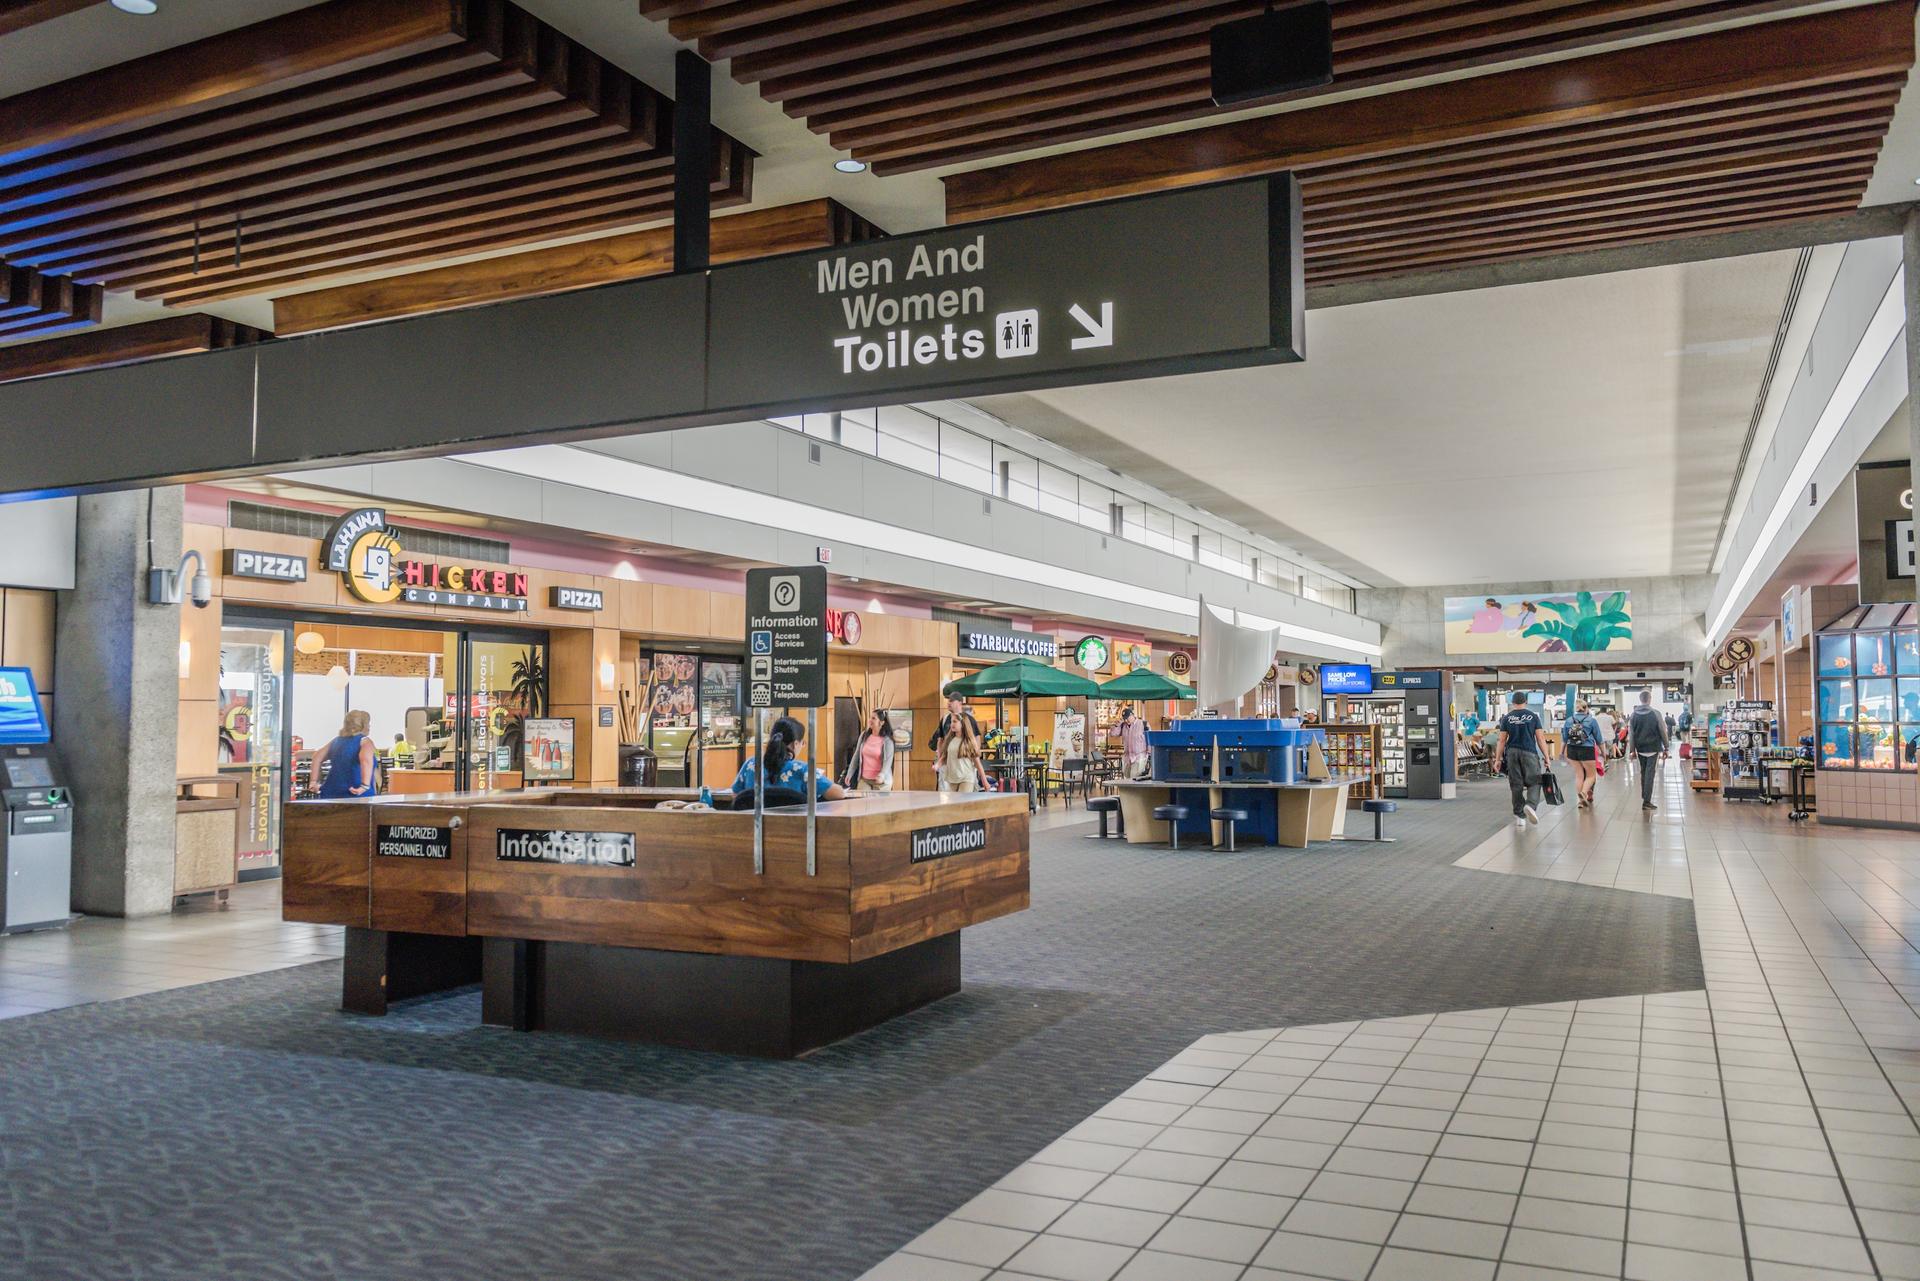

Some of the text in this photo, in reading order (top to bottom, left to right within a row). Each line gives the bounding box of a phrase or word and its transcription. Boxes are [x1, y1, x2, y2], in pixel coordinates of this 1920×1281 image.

[818, 235, 984, 293] Men And
[842, 286, 984, 329] Women
[834, 324, 985, 373] Toilets
[332, 511, 383, 567] LAHAINA
[237, 553, 306, 579] PIZZA
[408, 589, 526, 610] COMPANY
[560, 590, 602, 608] PIZZA
[751, 615, 818, 628] Information
[774, 632, 801, 640] Access
[774, 640, 805, 648] Services
[969, 633, 1058, 657] STARBUCKS COFFEE
[774, 658, 818, 666] Interterminal
[774, 666, 799, 674] Shuttle
[774, 691, 809, 700] Telephone
[258, 783, 271, 842] Flavors
[388, 825, 438, 839] AUTHORIZED
[913, 825, 985, 859] Information
[379, 843, 447, 858] PERSONNEL ONLY
[500, 833, 632, 863] Information
